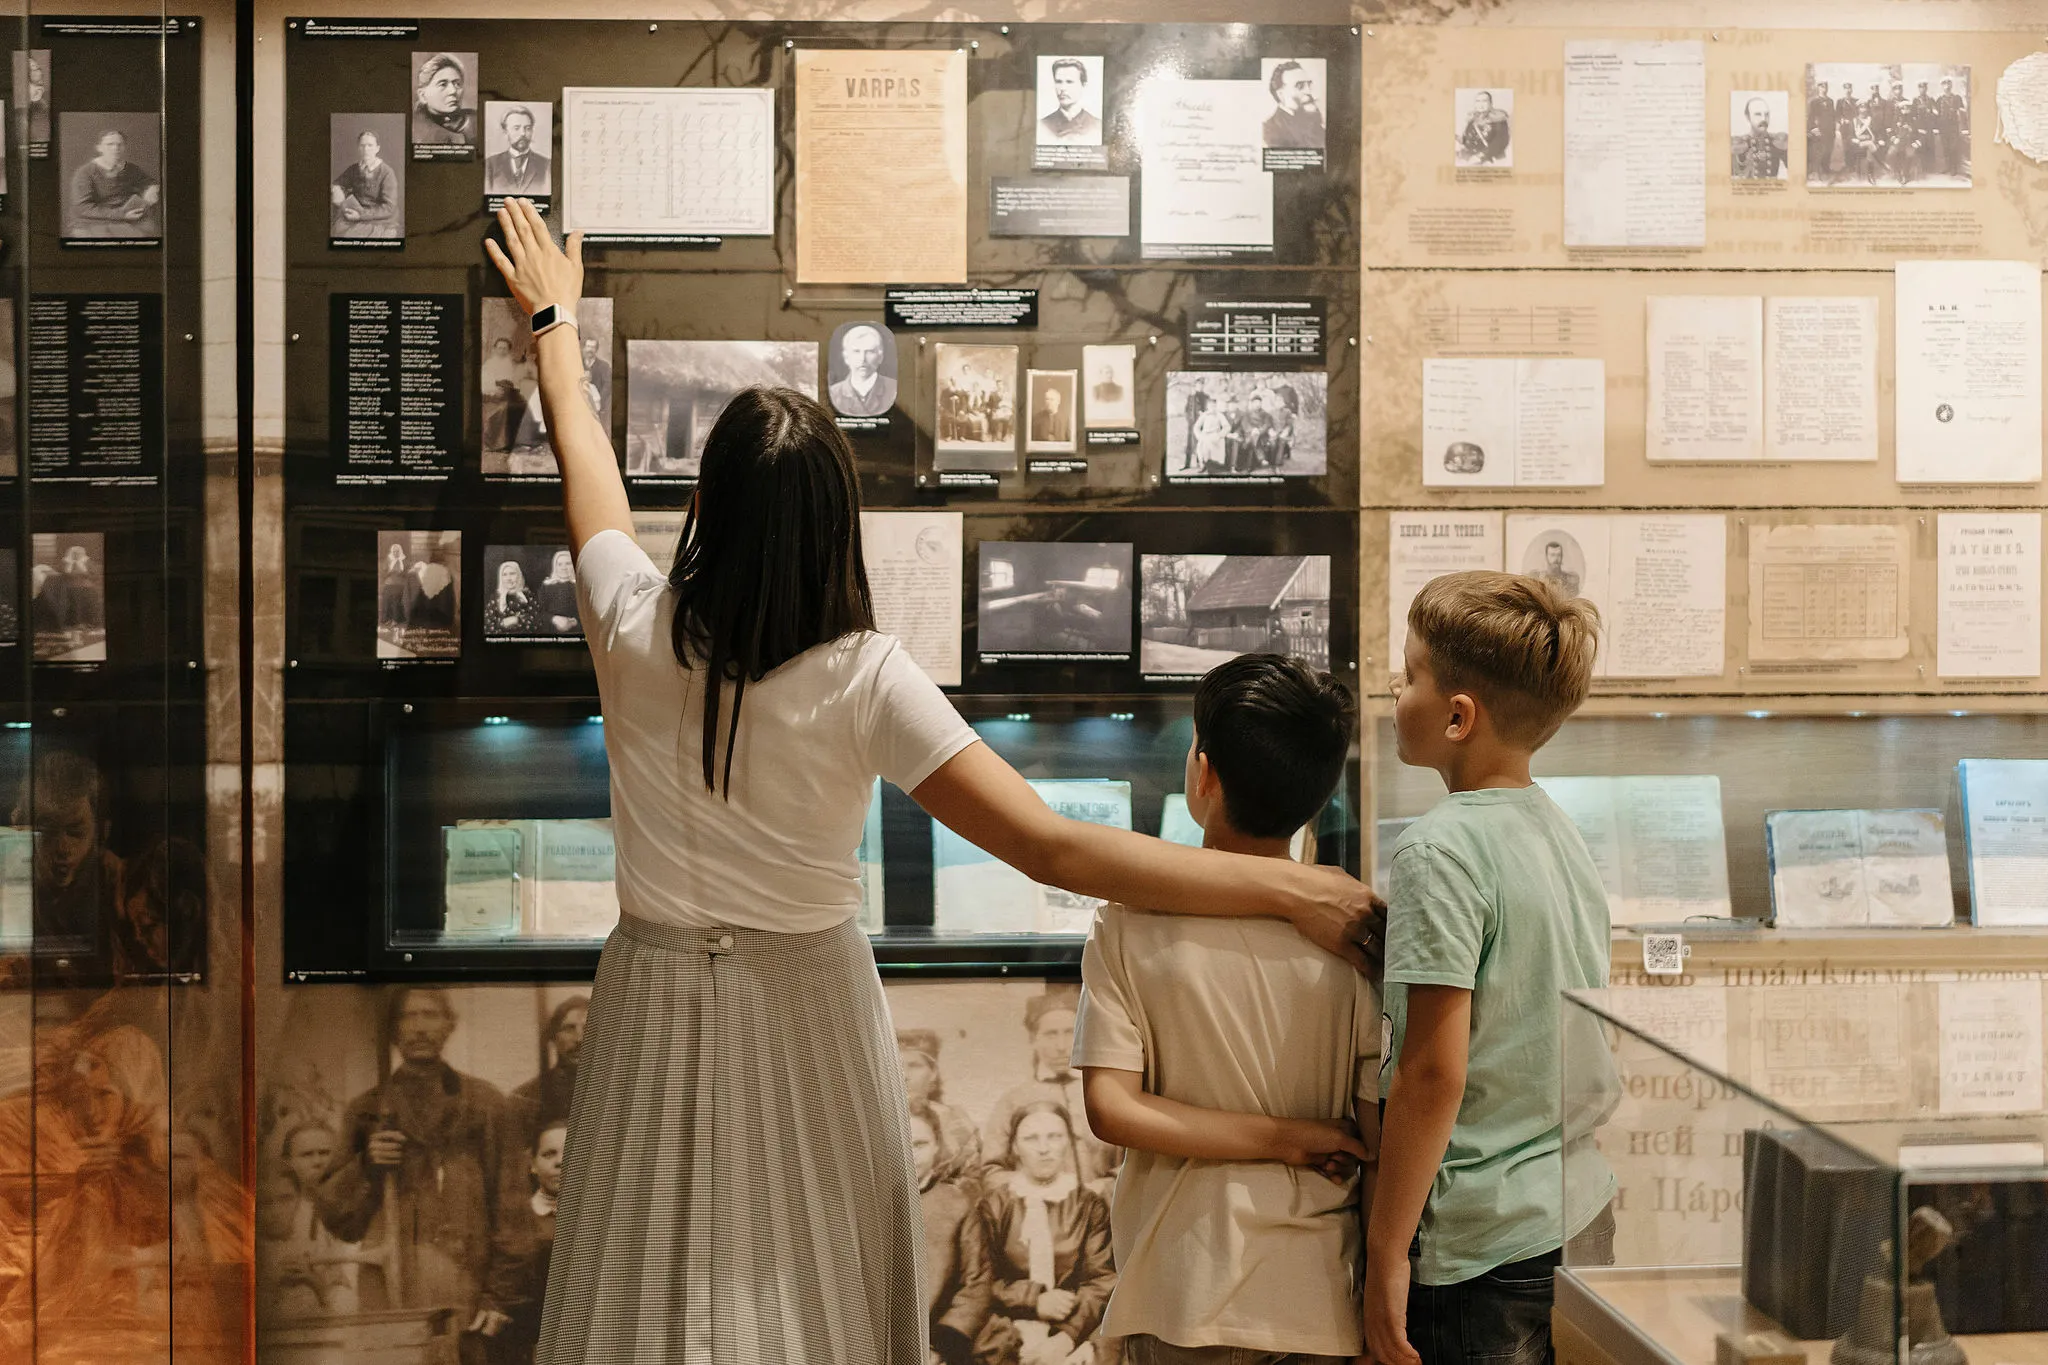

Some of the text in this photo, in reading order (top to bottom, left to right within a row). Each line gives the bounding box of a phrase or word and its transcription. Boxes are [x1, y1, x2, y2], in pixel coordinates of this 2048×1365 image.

[845, 77, 921, 98] VARPAS
[1618, 1068, 1739, 1110] епéрь
[1652, 1175, 1744, 1222] Цáрс
